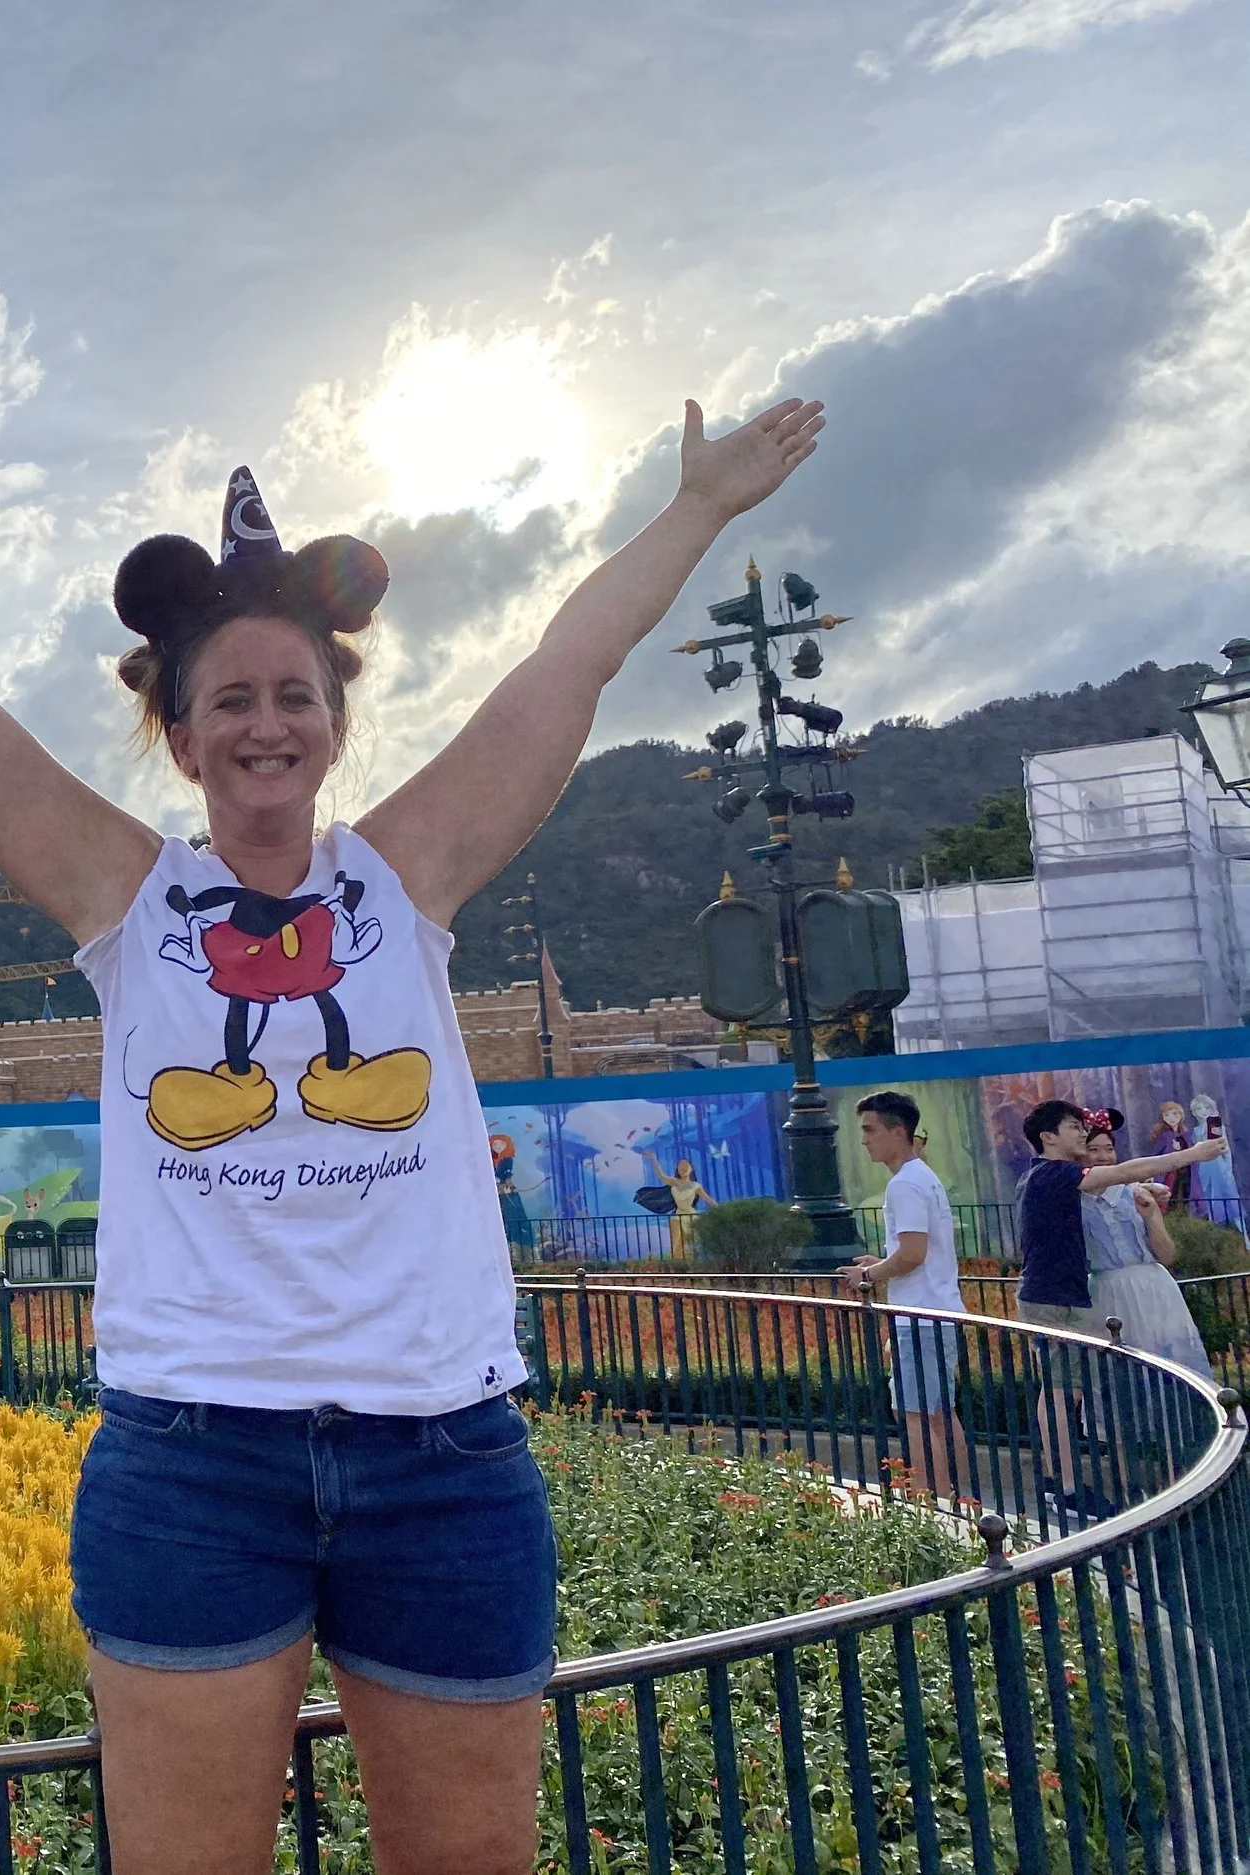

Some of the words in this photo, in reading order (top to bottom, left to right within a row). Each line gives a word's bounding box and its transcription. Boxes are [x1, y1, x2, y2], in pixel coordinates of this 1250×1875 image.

[158, 1157, 211, 1196] Hong
[218, 1162, 286, 1201] Kong
[297, 1142, 427, 1201] Disneyland
